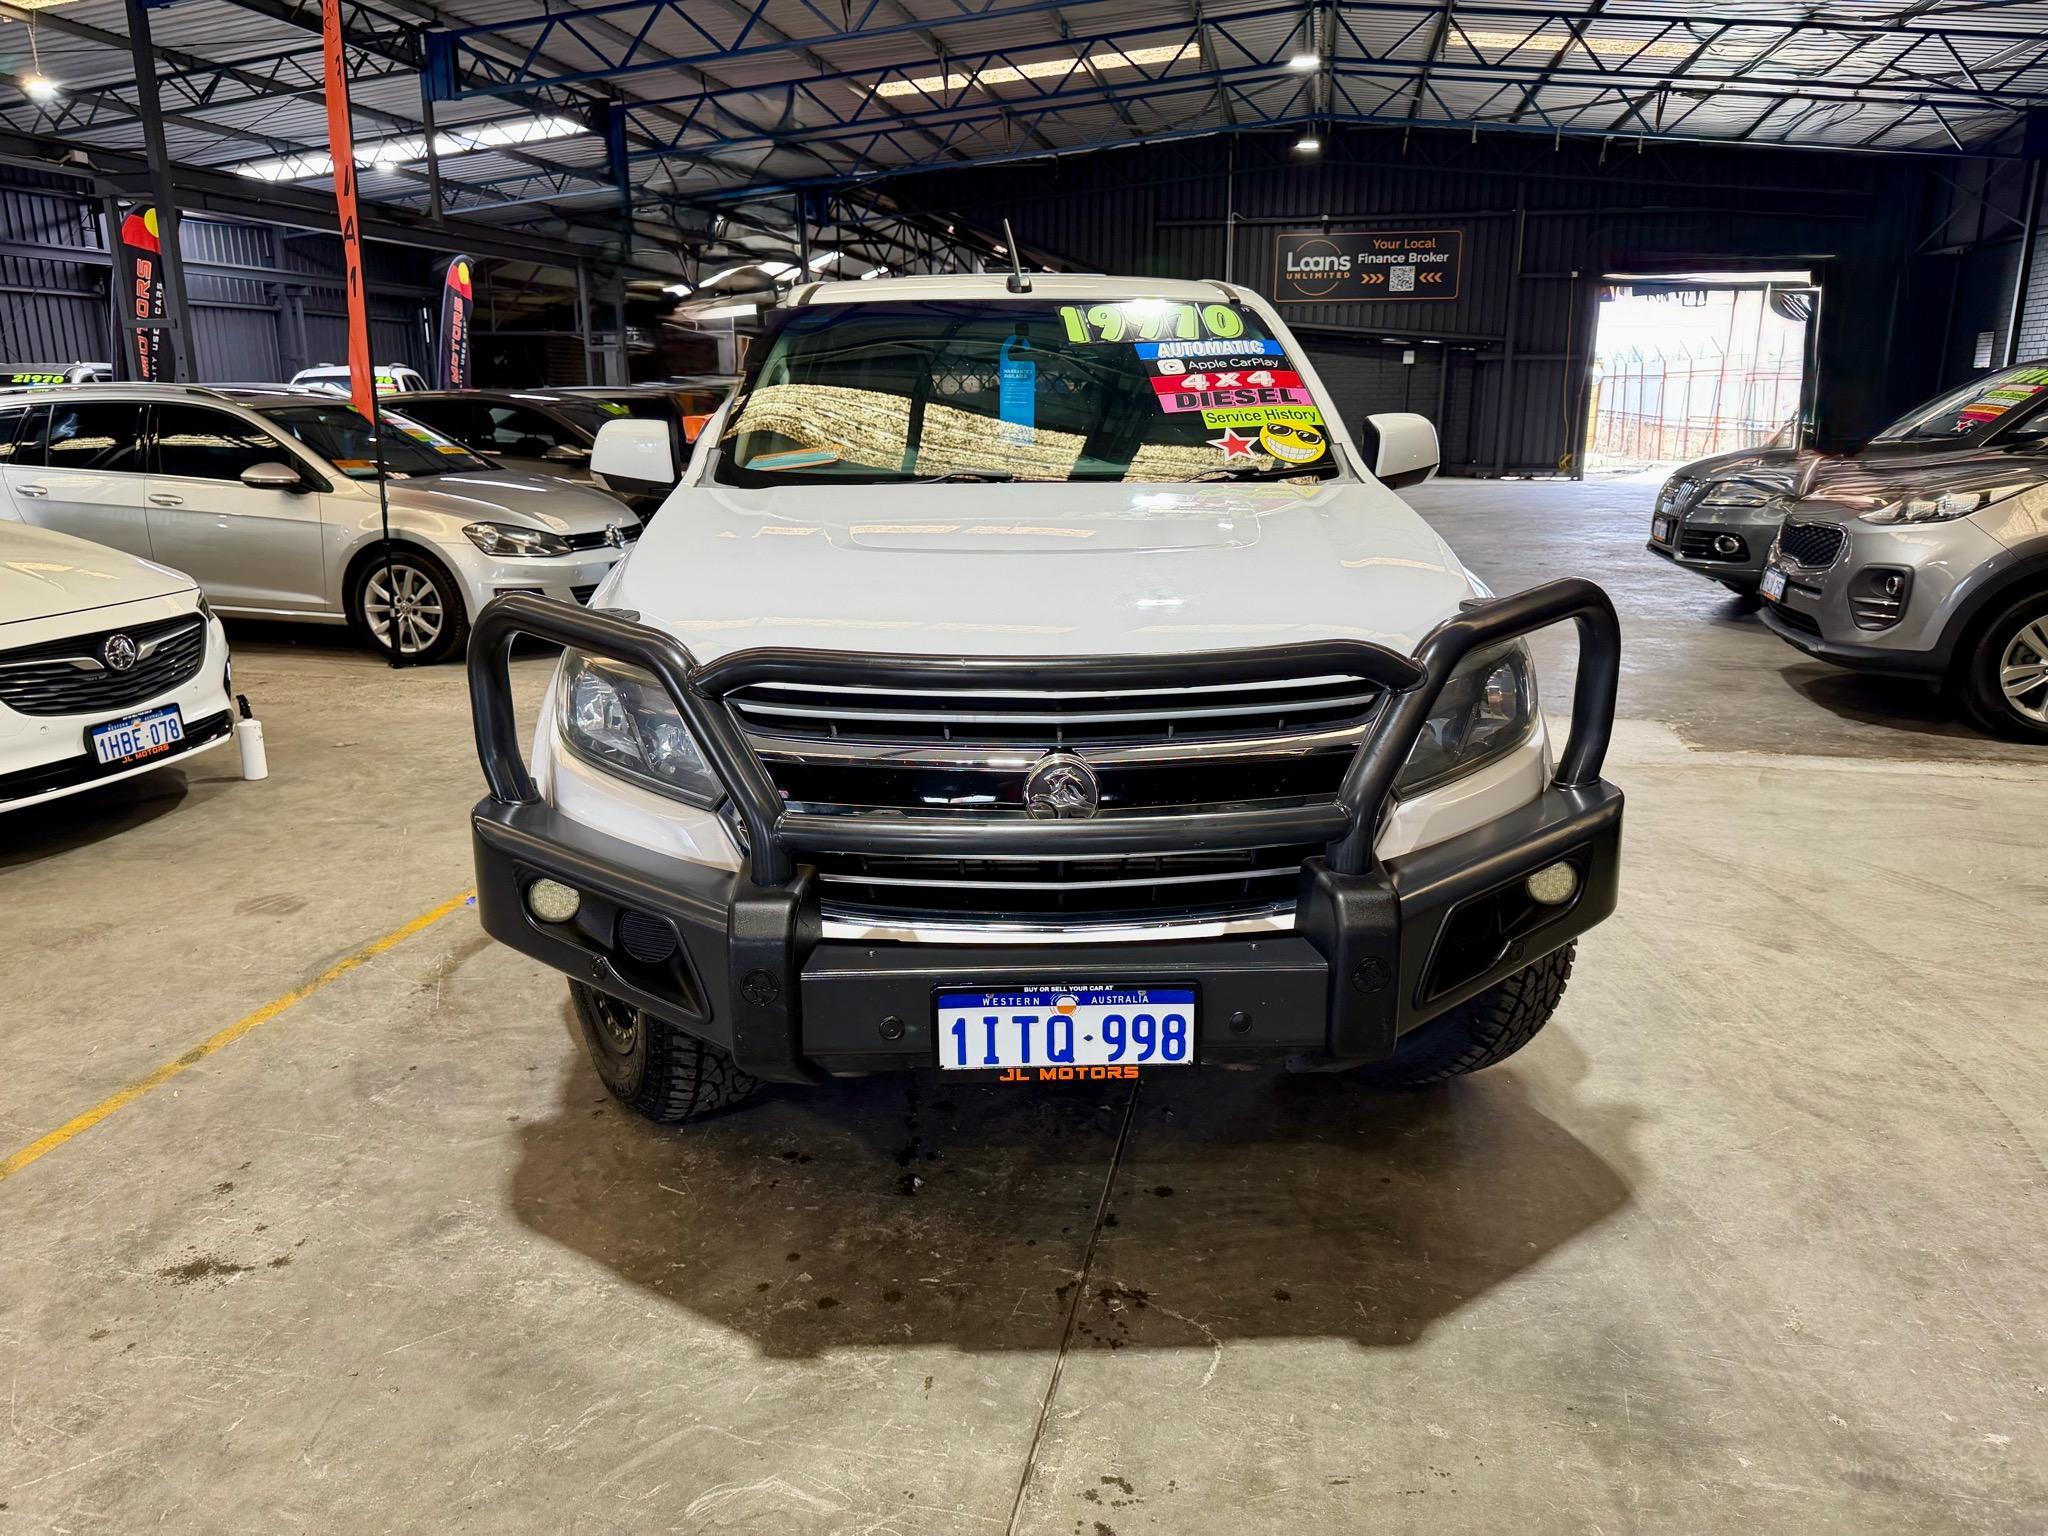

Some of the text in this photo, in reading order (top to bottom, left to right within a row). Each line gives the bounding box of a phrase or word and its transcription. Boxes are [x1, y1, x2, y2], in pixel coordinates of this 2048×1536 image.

[1373, 238, 1436, 249] Your Local
[1286, 252, 1351, 272] Loans
[1357, 252, 1449, 264] Finance Broker
[1286, 272, 1350, 280] UNLIMITED
[451, 296, 463, 384] MOTORS
[1158, 340, 1265, 358] AUTOMATIC
[1188, 357, 1279, 371] Apple CarPlay
[11, 373, 65, 384] 21970
[1175, 388, 1302, 409] DIESEL
[1206, 409, 1316, 424] Service History
[122, 743, 169, 764] JL MOTORS
[982, 995, 1149, 1006] WESTERN AUSTRALIA
[1000, 1066, 1139, 1081] JL MOTORS
